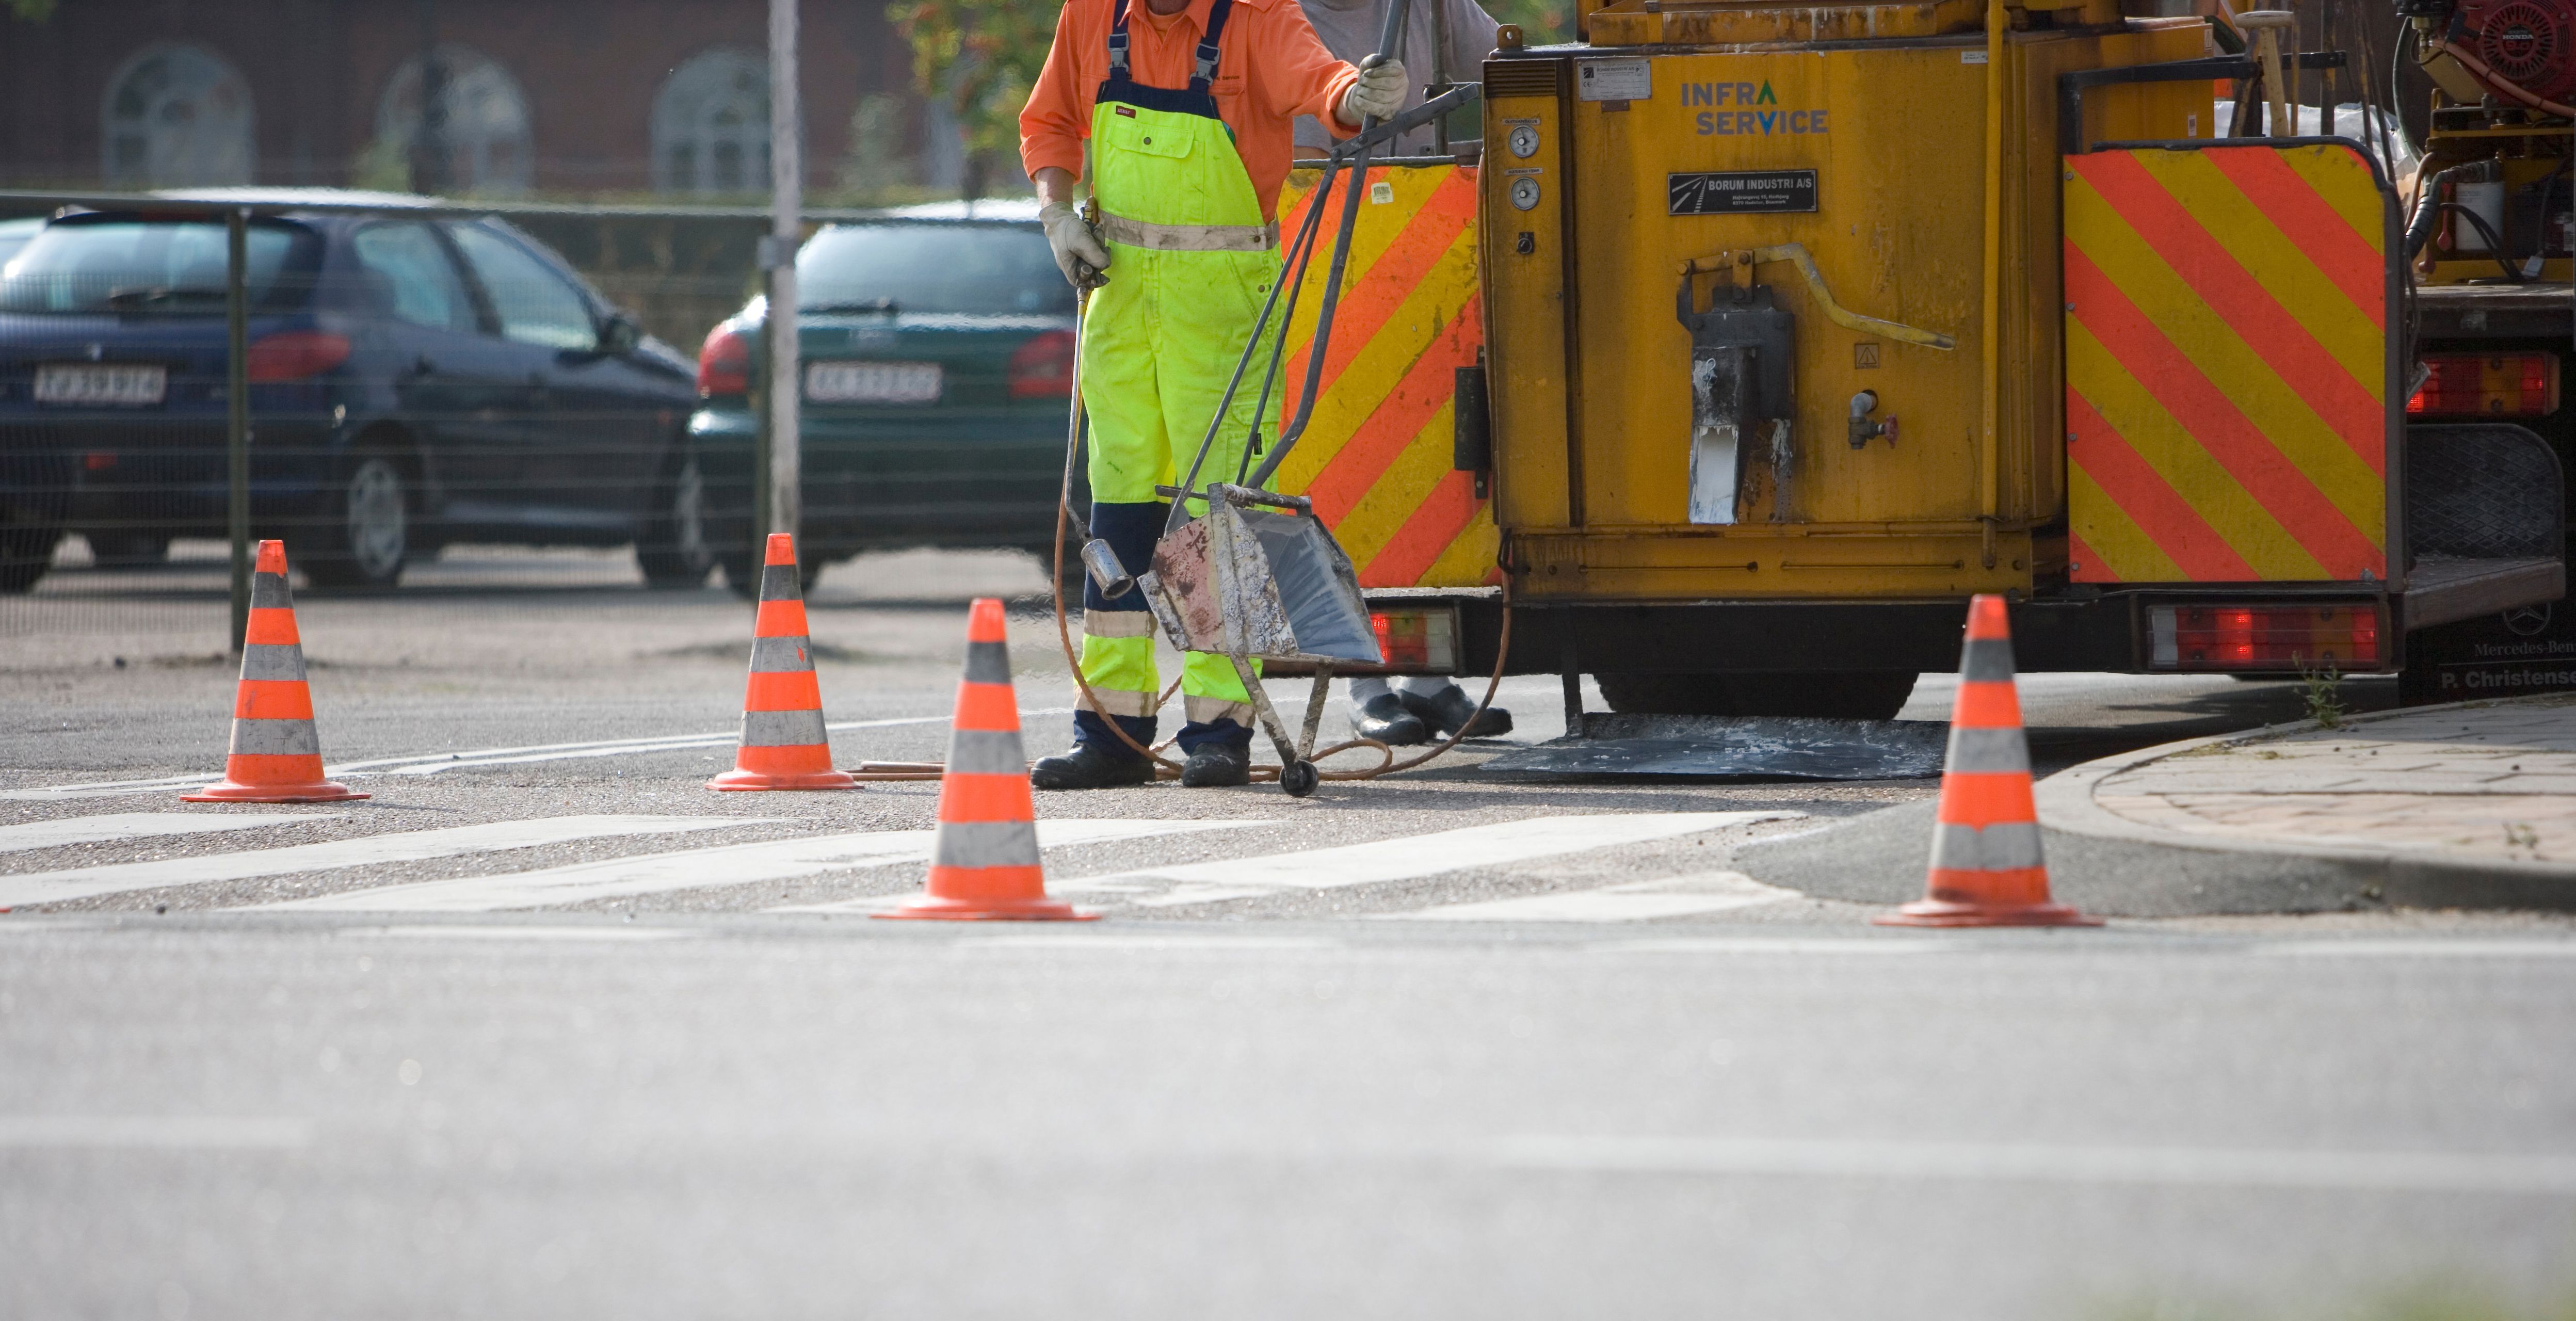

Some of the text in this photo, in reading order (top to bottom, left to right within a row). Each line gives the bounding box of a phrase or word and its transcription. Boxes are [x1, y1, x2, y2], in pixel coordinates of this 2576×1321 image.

[1681, 79, 1778, 106] INFRA
[1696, 109, 1828, 137] SERVICE
[1709, 178, 1812, 190] BORUM INDUSTRI A/S
[2475, 641, 2576, 656] Mercedes-Ben
[2441, 672, 2458, 689] P.
